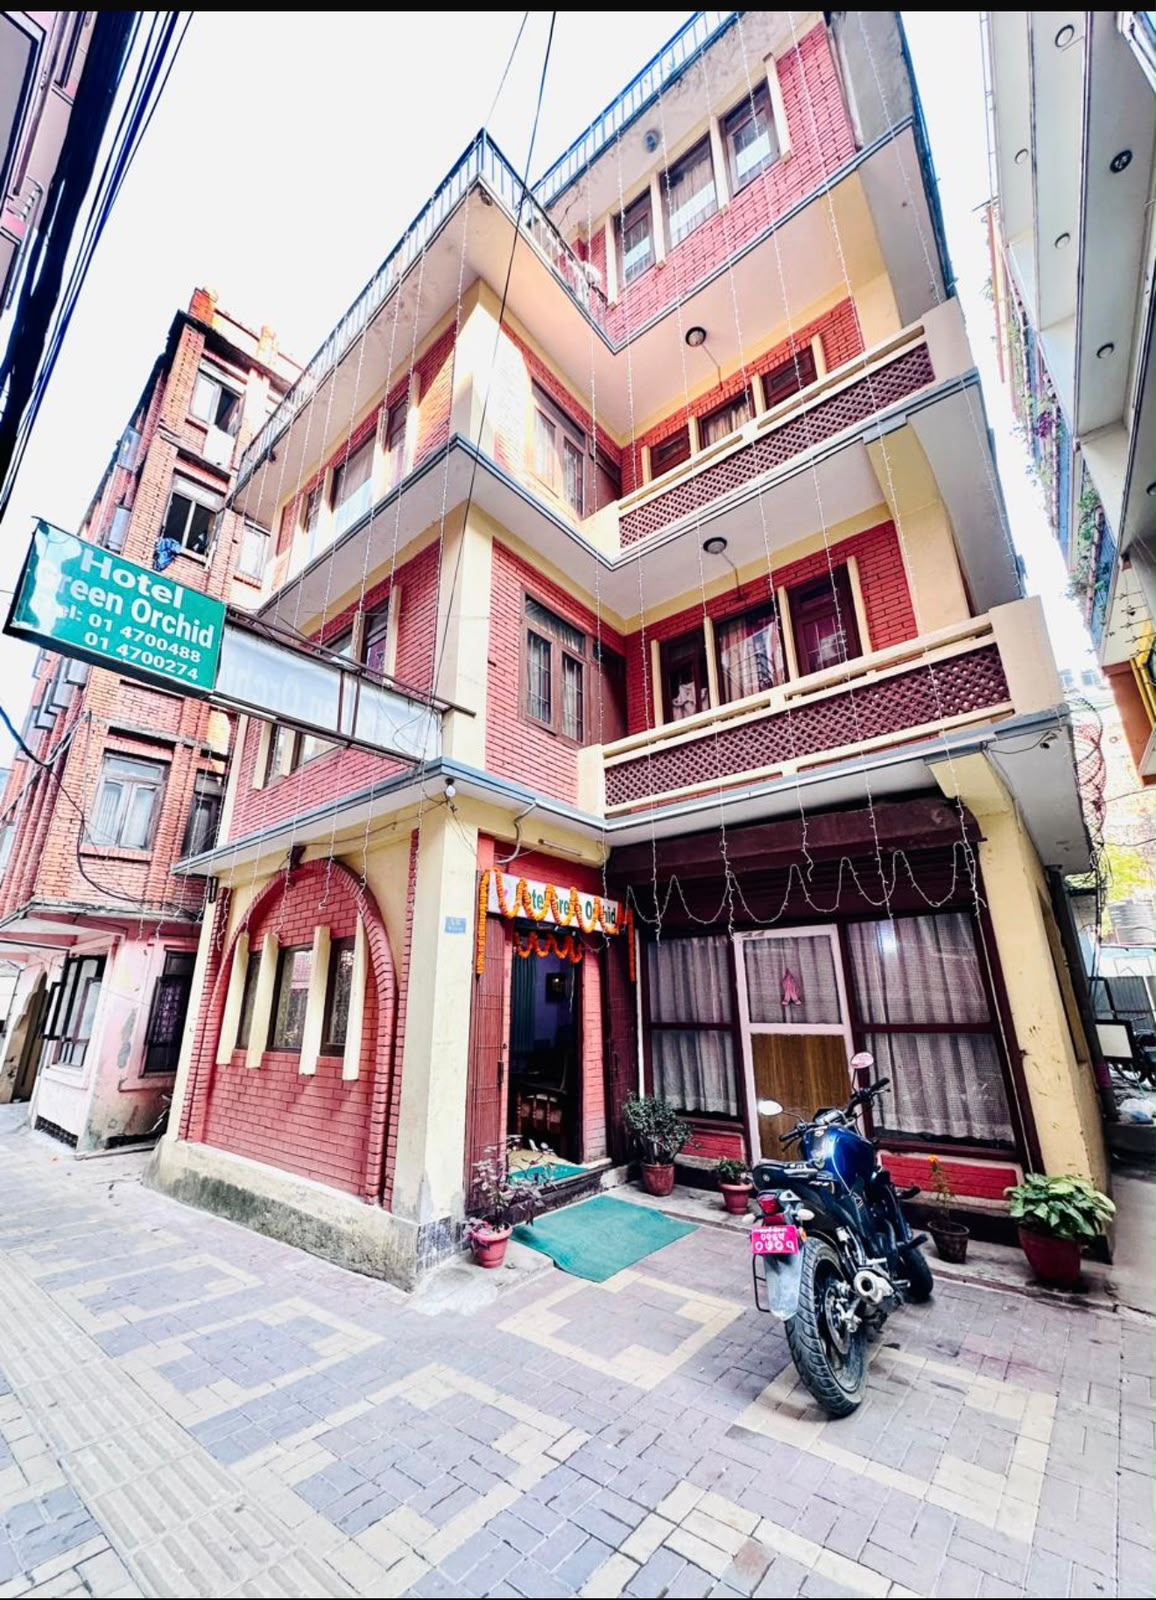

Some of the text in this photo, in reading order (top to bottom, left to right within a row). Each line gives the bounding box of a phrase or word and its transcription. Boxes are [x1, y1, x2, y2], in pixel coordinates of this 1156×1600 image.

[80, 548, 184, 609] Hotel
[88, 613, 114, 632] 01
[120, 625, 202, 664] 4700488
[131, 598, 215, 649] Orchid
[84, 631, 199, 681] 01 4700274
